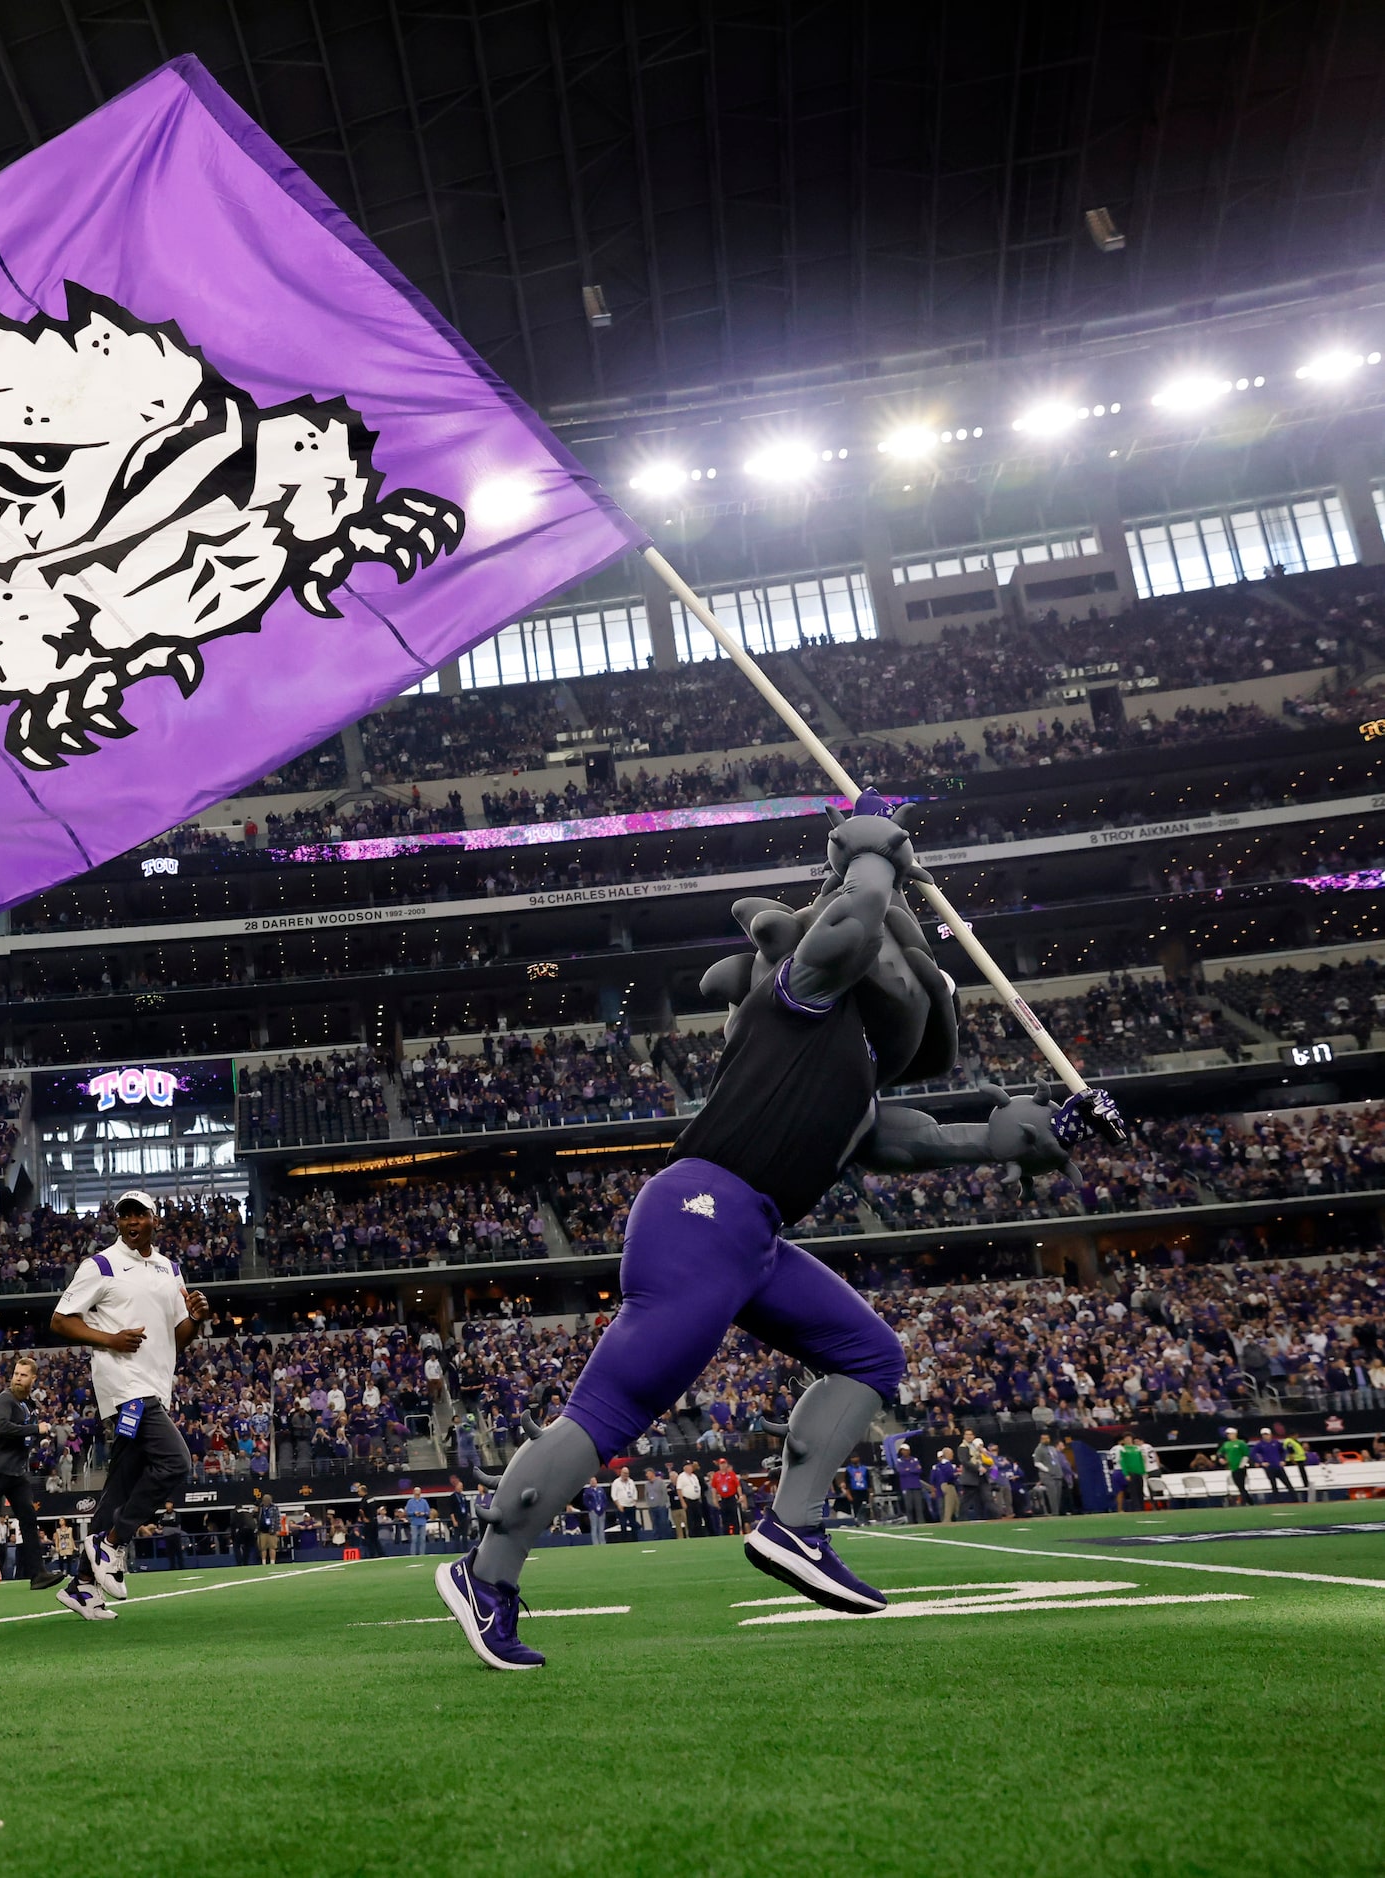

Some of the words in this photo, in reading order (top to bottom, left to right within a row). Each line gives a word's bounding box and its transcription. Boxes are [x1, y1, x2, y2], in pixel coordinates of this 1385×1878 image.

[525, 825, 565, 845] TCU
[1090, 833, 1098, 844] 8
[1101, 829, 1135, 843] TROY
[1139, 823, 1190, 839] AIKMAN
[141, 857, 179, 877] TCU
[529, 896, 545, 907] 94
[547, 889, 606, 905] CHARLES
[609, 885, 649, 899] HALEY
[244, 922, 258, 931] 28
[262, 916, 314, 929] DARREN
[318, 911, 382, 924] WOODSON
[89, 1068, 178, 1111] TCU
[185, 1491, 217, 1502] ESPN
[345, 1550, 356, 1560] 10
